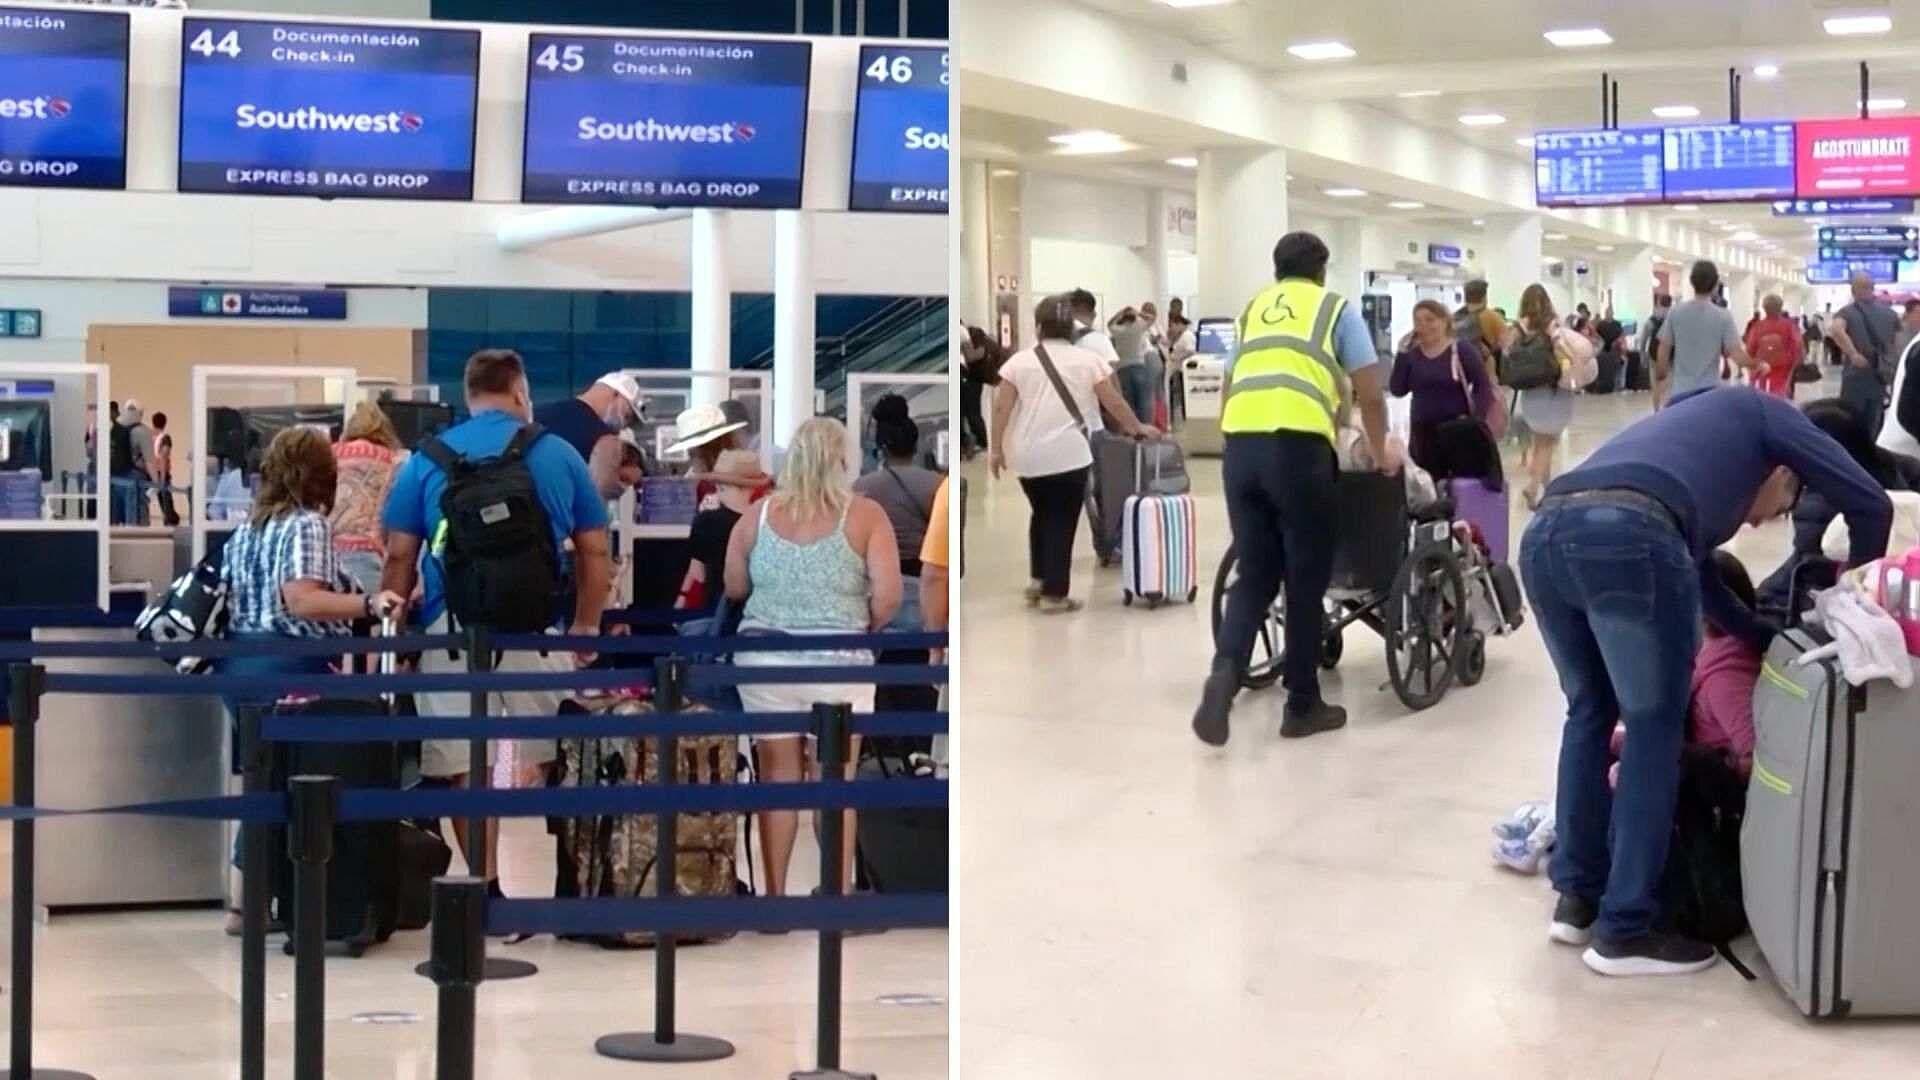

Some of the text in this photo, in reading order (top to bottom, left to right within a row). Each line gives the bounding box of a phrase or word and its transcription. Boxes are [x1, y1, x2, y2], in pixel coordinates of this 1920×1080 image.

[190, 28, 242, 58] 44
[272, 28, 420, 46] Documentación
[271, 47, 356, 63] Check-in
[536, 44, 585, 72] 45
[614, 42, 754, 59] Documentación
[612, 61, 693, 76] Check-in
[865, 55, 913, 83] 46
[236, 104, 401, 133] Southwest
[578, 116, 734, 143] Southwest
[19, 160, 79, 176] DROP
[226, 168, 429, 189] EXPRESS BAG DROP
[567, 179, 760, 198] EXPRESS BAG DROP
